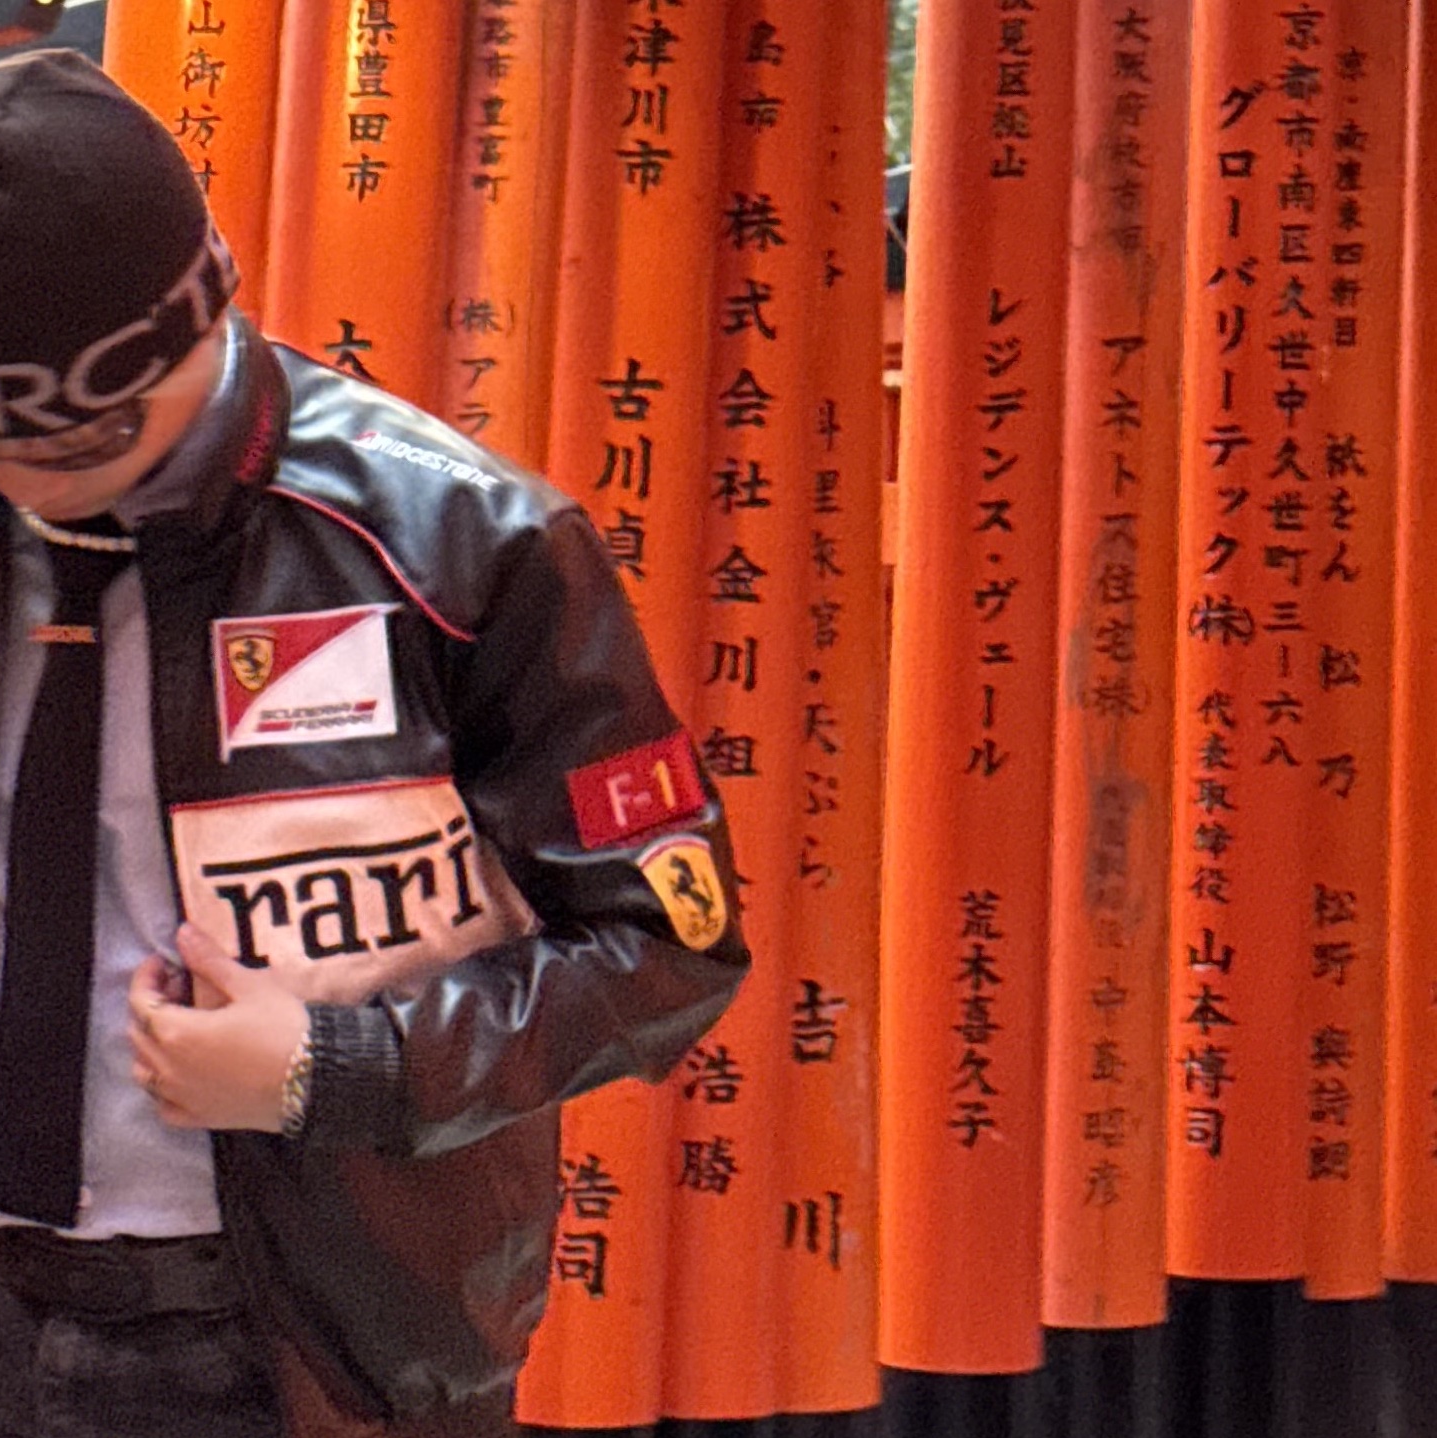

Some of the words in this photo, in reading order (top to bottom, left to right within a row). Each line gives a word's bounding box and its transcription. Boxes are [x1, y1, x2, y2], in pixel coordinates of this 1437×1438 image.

[616, 0, 682, 195] 津川市
[700, 191, 786, 780] 株式会社金川組
